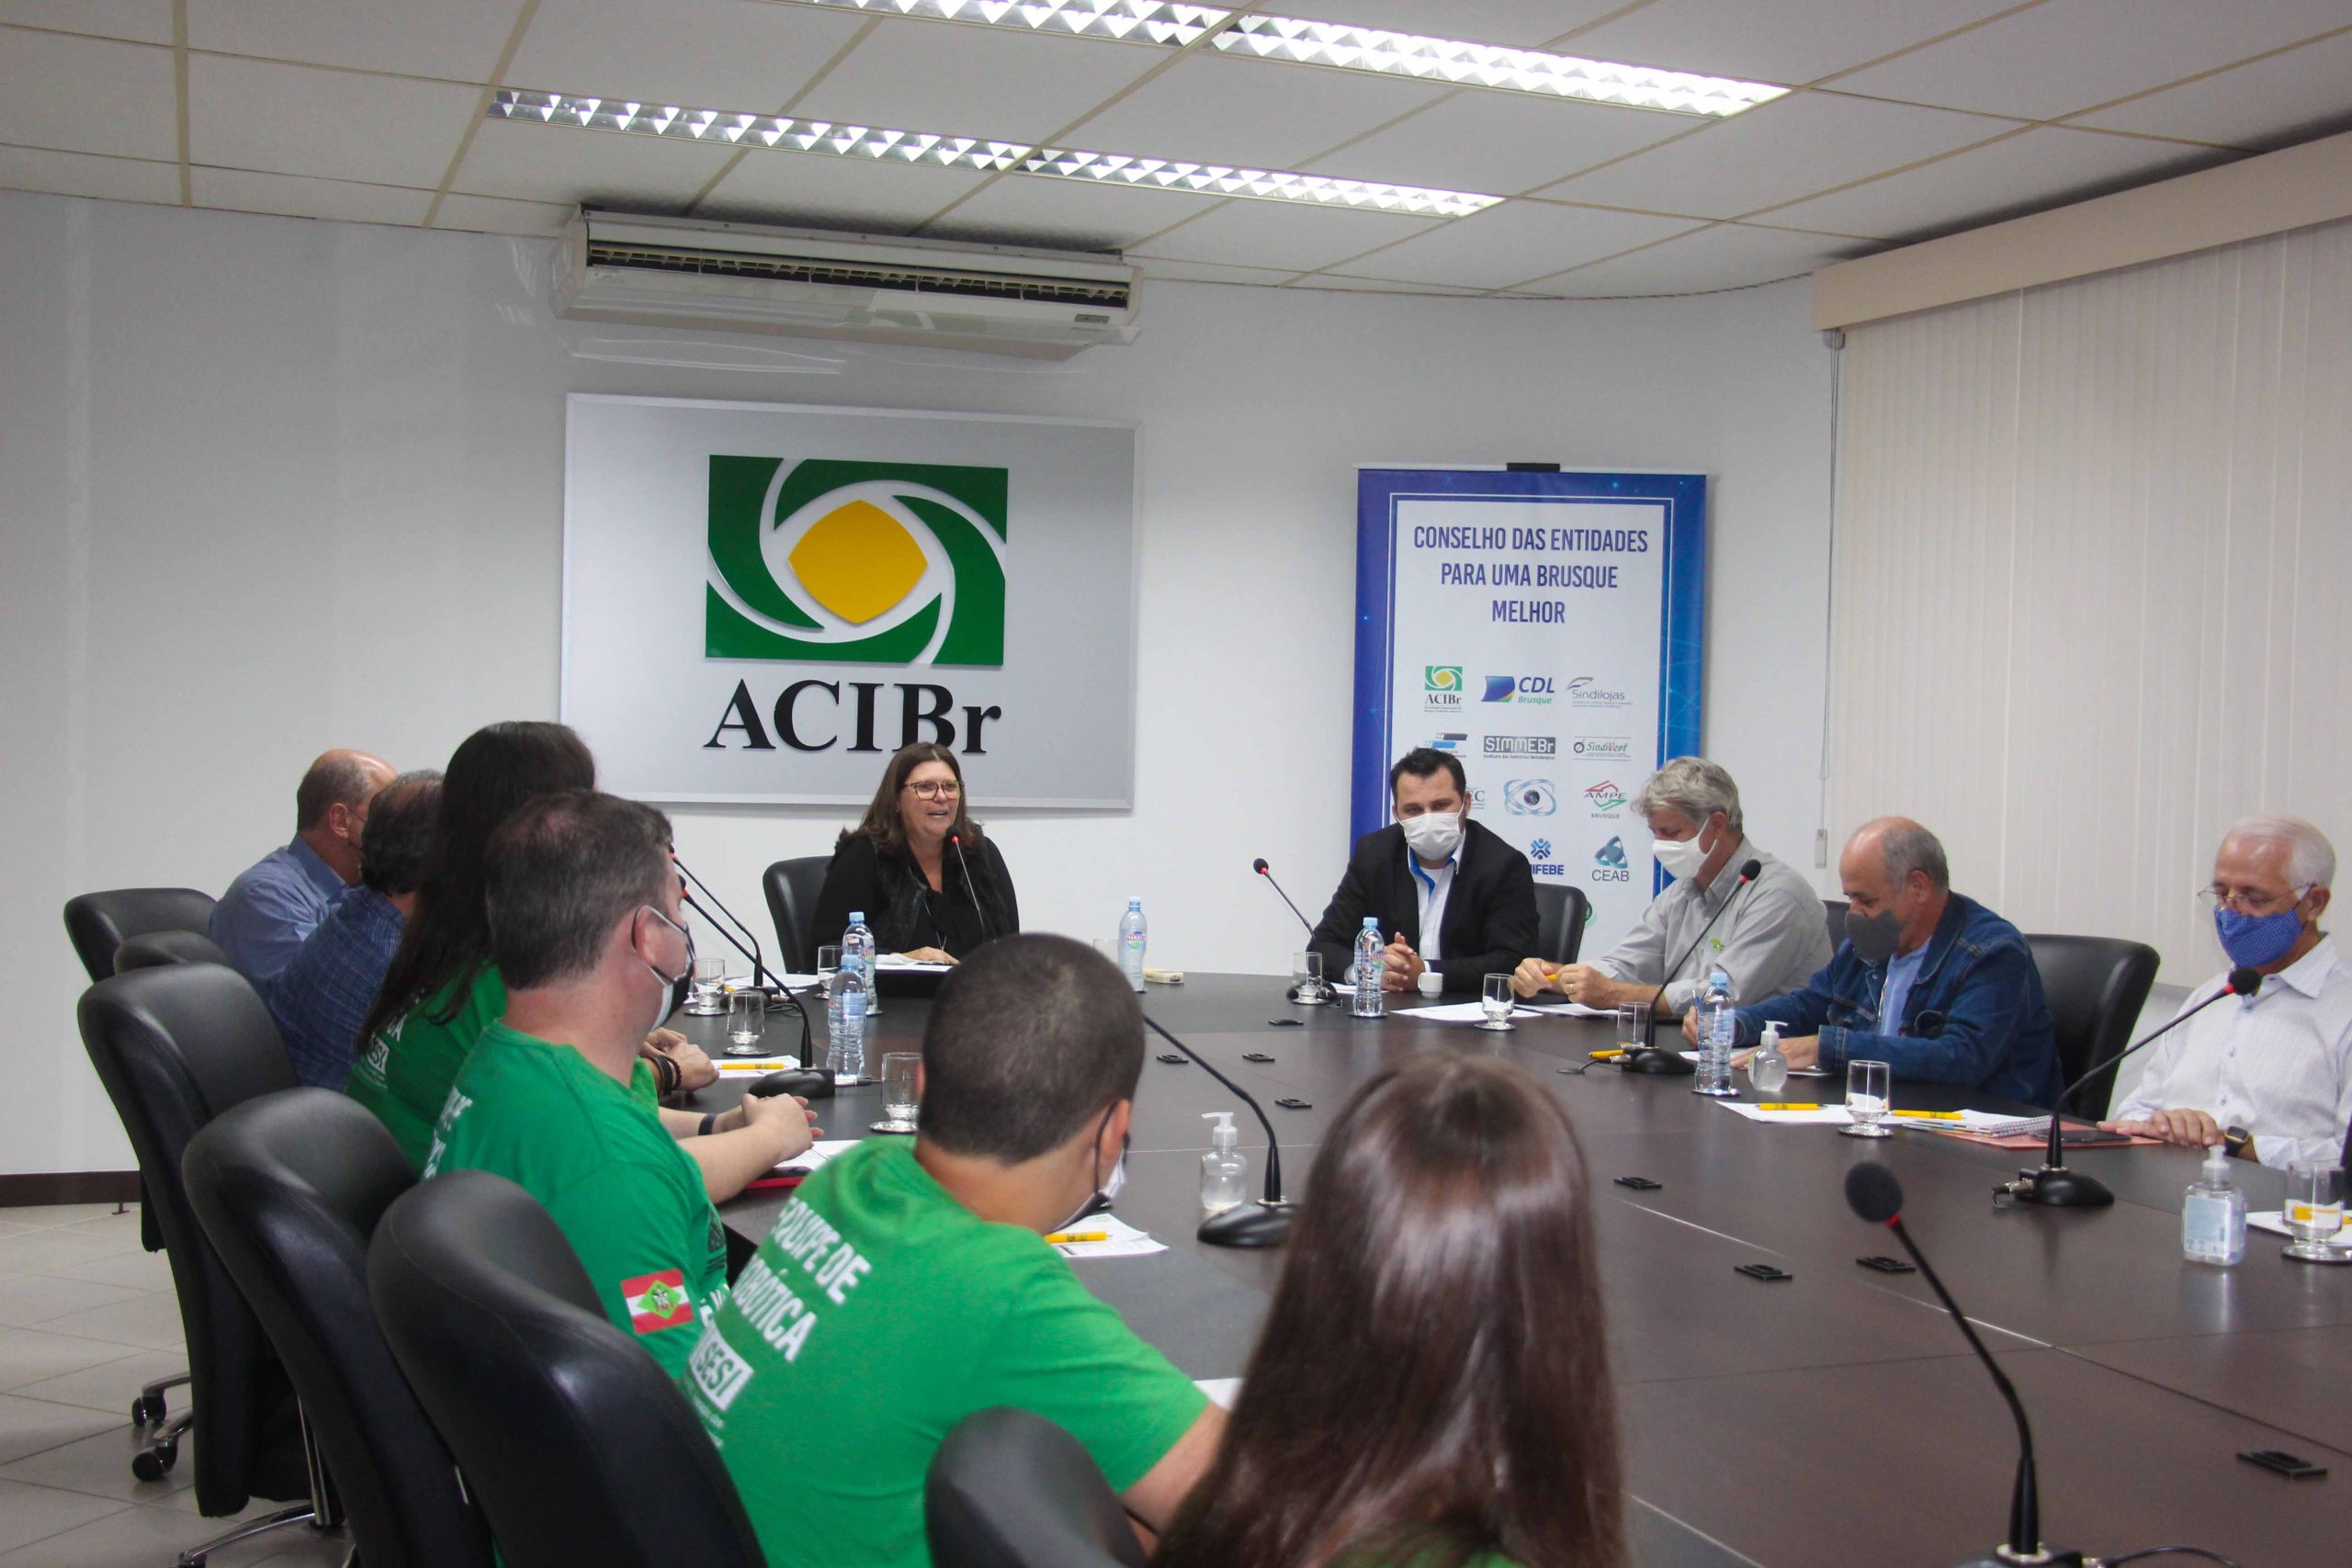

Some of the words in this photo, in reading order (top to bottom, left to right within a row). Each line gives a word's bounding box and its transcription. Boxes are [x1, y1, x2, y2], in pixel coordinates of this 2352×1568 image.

[1414, 525, 1506, 549] CONSELHO
[1512, 527, 1546, 550] DAS
[1550, 528, 1648, 552] ENTIDADES
[1441, 562, 1487, 585] PARA
[1491, 563, 1532, 586] UMA
[1536, 564, 1618, 589] BRUSQUE
[1492, 600, 1566, 624] MELHOR
[1519, 676, 1555, 694] CDL
[1425, 694, 1462, 705] ACIBr
[1518, 695, 1553, 705] Brusque
[1572, 689, 1625, 701] Sindilojas
[704, 678, 1002, 755] ACIBr
[1485, 737, 1554, 752] SIMMEBr
[1531, 864, 1565, 875] IFEBE
[1591, 869, 1630, 882] CEAB
[814, 1242, 872, 1305] DE
[695, 1341, 743, 1398] SESI
